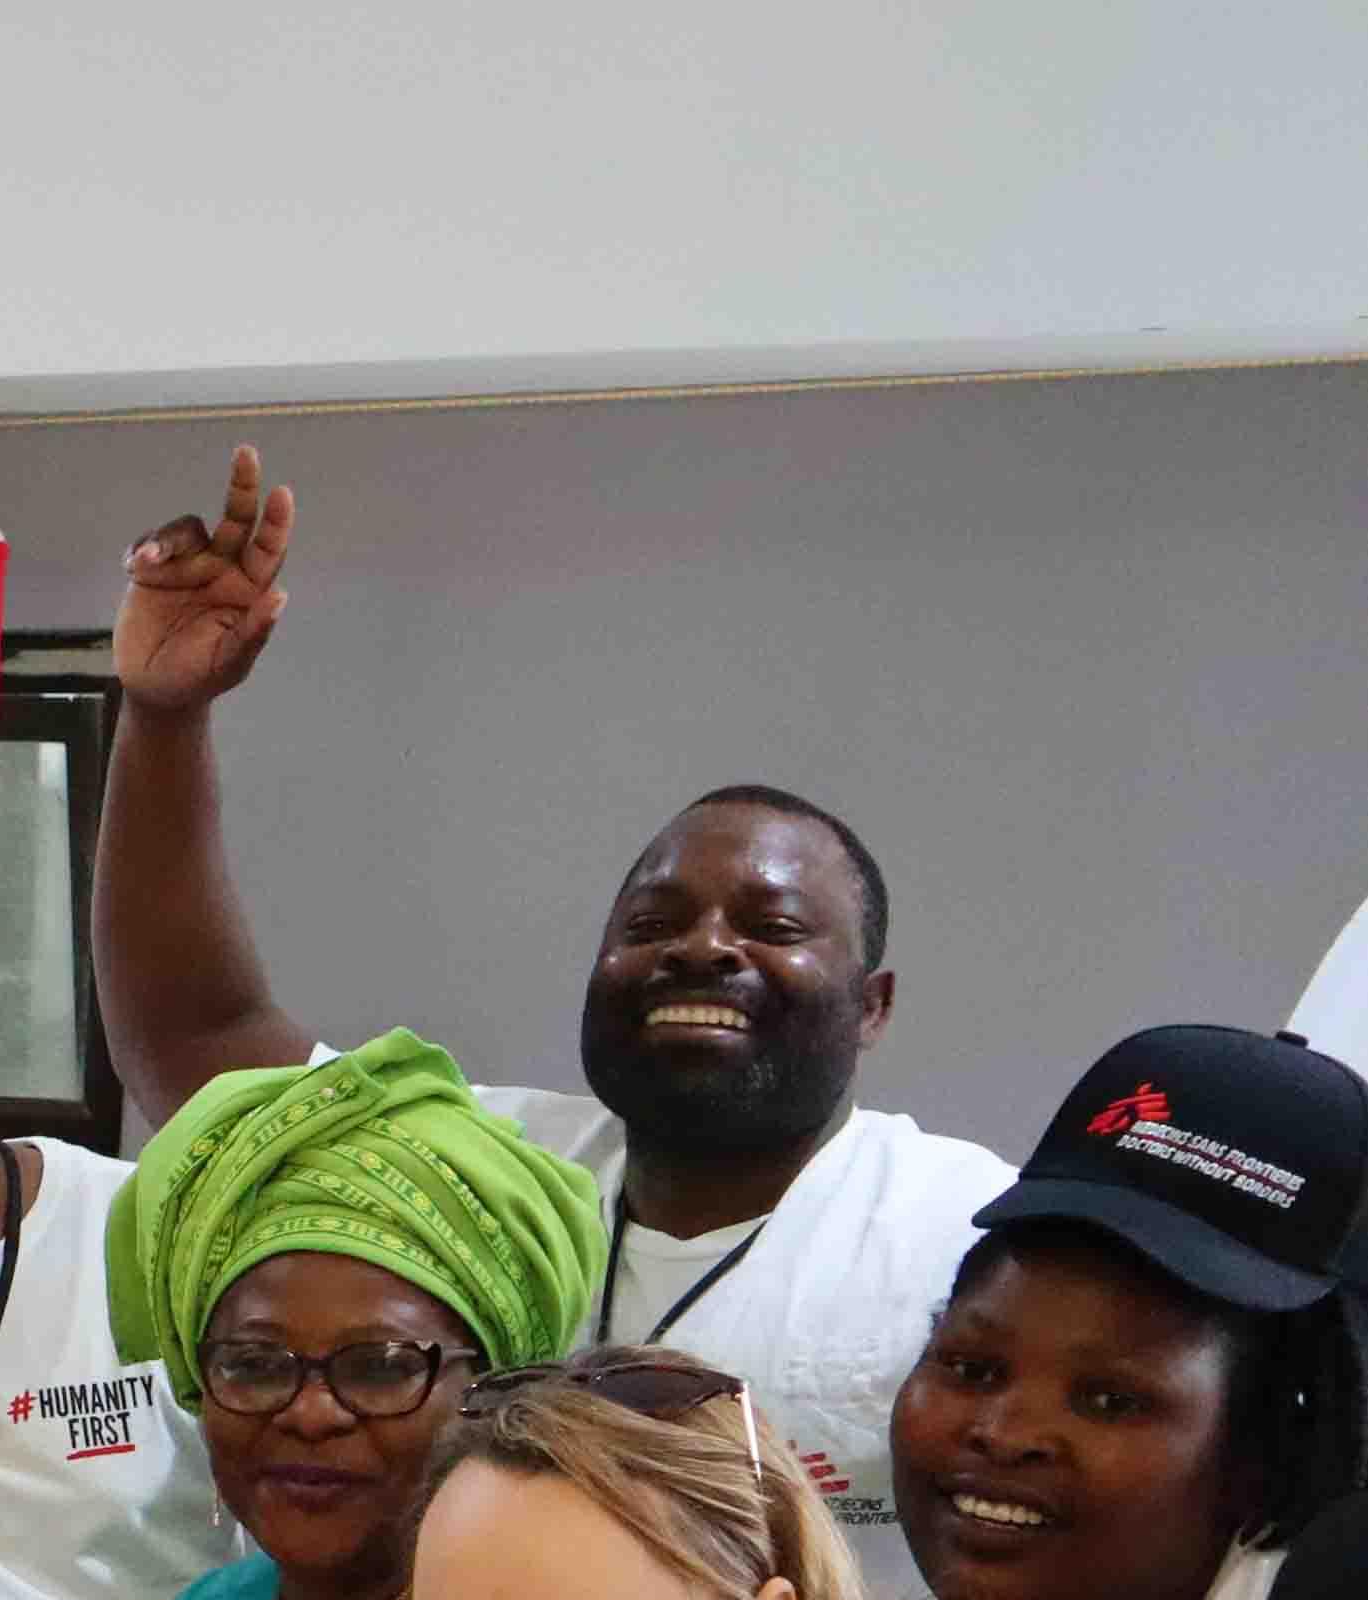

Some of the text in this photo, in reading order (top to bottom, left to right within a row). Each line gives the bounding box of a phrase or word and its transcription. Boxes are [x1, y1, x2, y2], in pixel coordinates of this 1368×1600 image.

[1171, 1146, 1236, 1182] WITHOUT
[1186, 1134, 1229, 1158] SANS
[6, 1373, 154, 1424] #HUMANITY
[68, 1411, 131, 1449] FIRST
